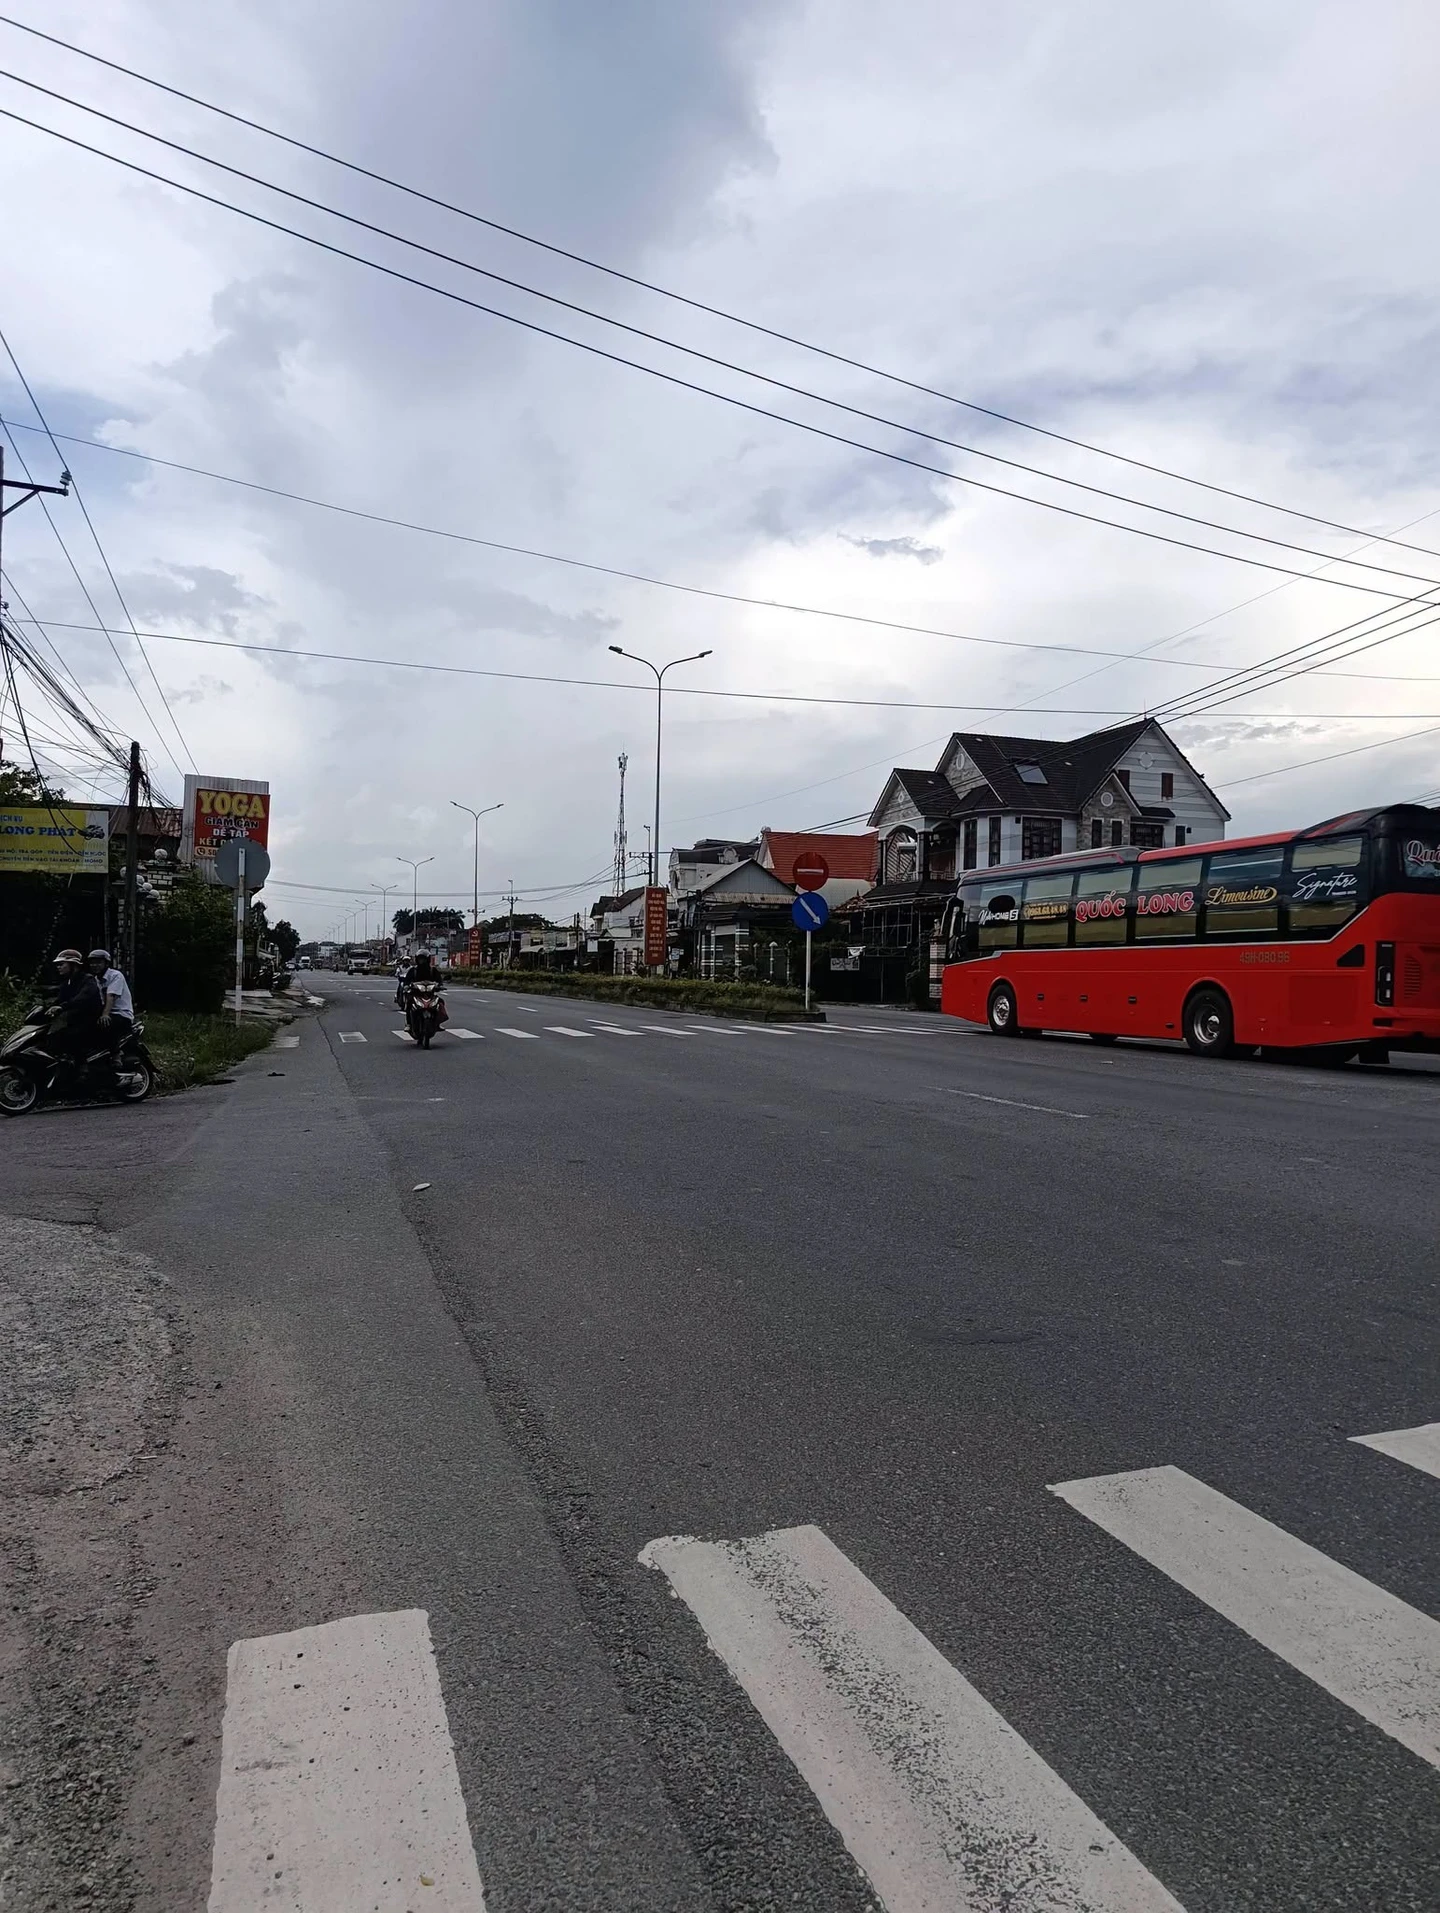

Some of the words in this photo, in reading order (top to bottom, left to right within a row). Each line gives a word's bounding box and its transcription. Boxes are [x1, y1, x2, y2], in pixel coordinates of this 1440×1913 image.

[199, 791, 266, 818] YOGA
[38, 825, 76, 836] PHÁT
[1292, 872, 1358, 900] Signature
[1075, 890, 1127, 923] QUỐC
[1137, 891, 1194, 915] LONG
[1205, 886, 1277, 905] Limousine
